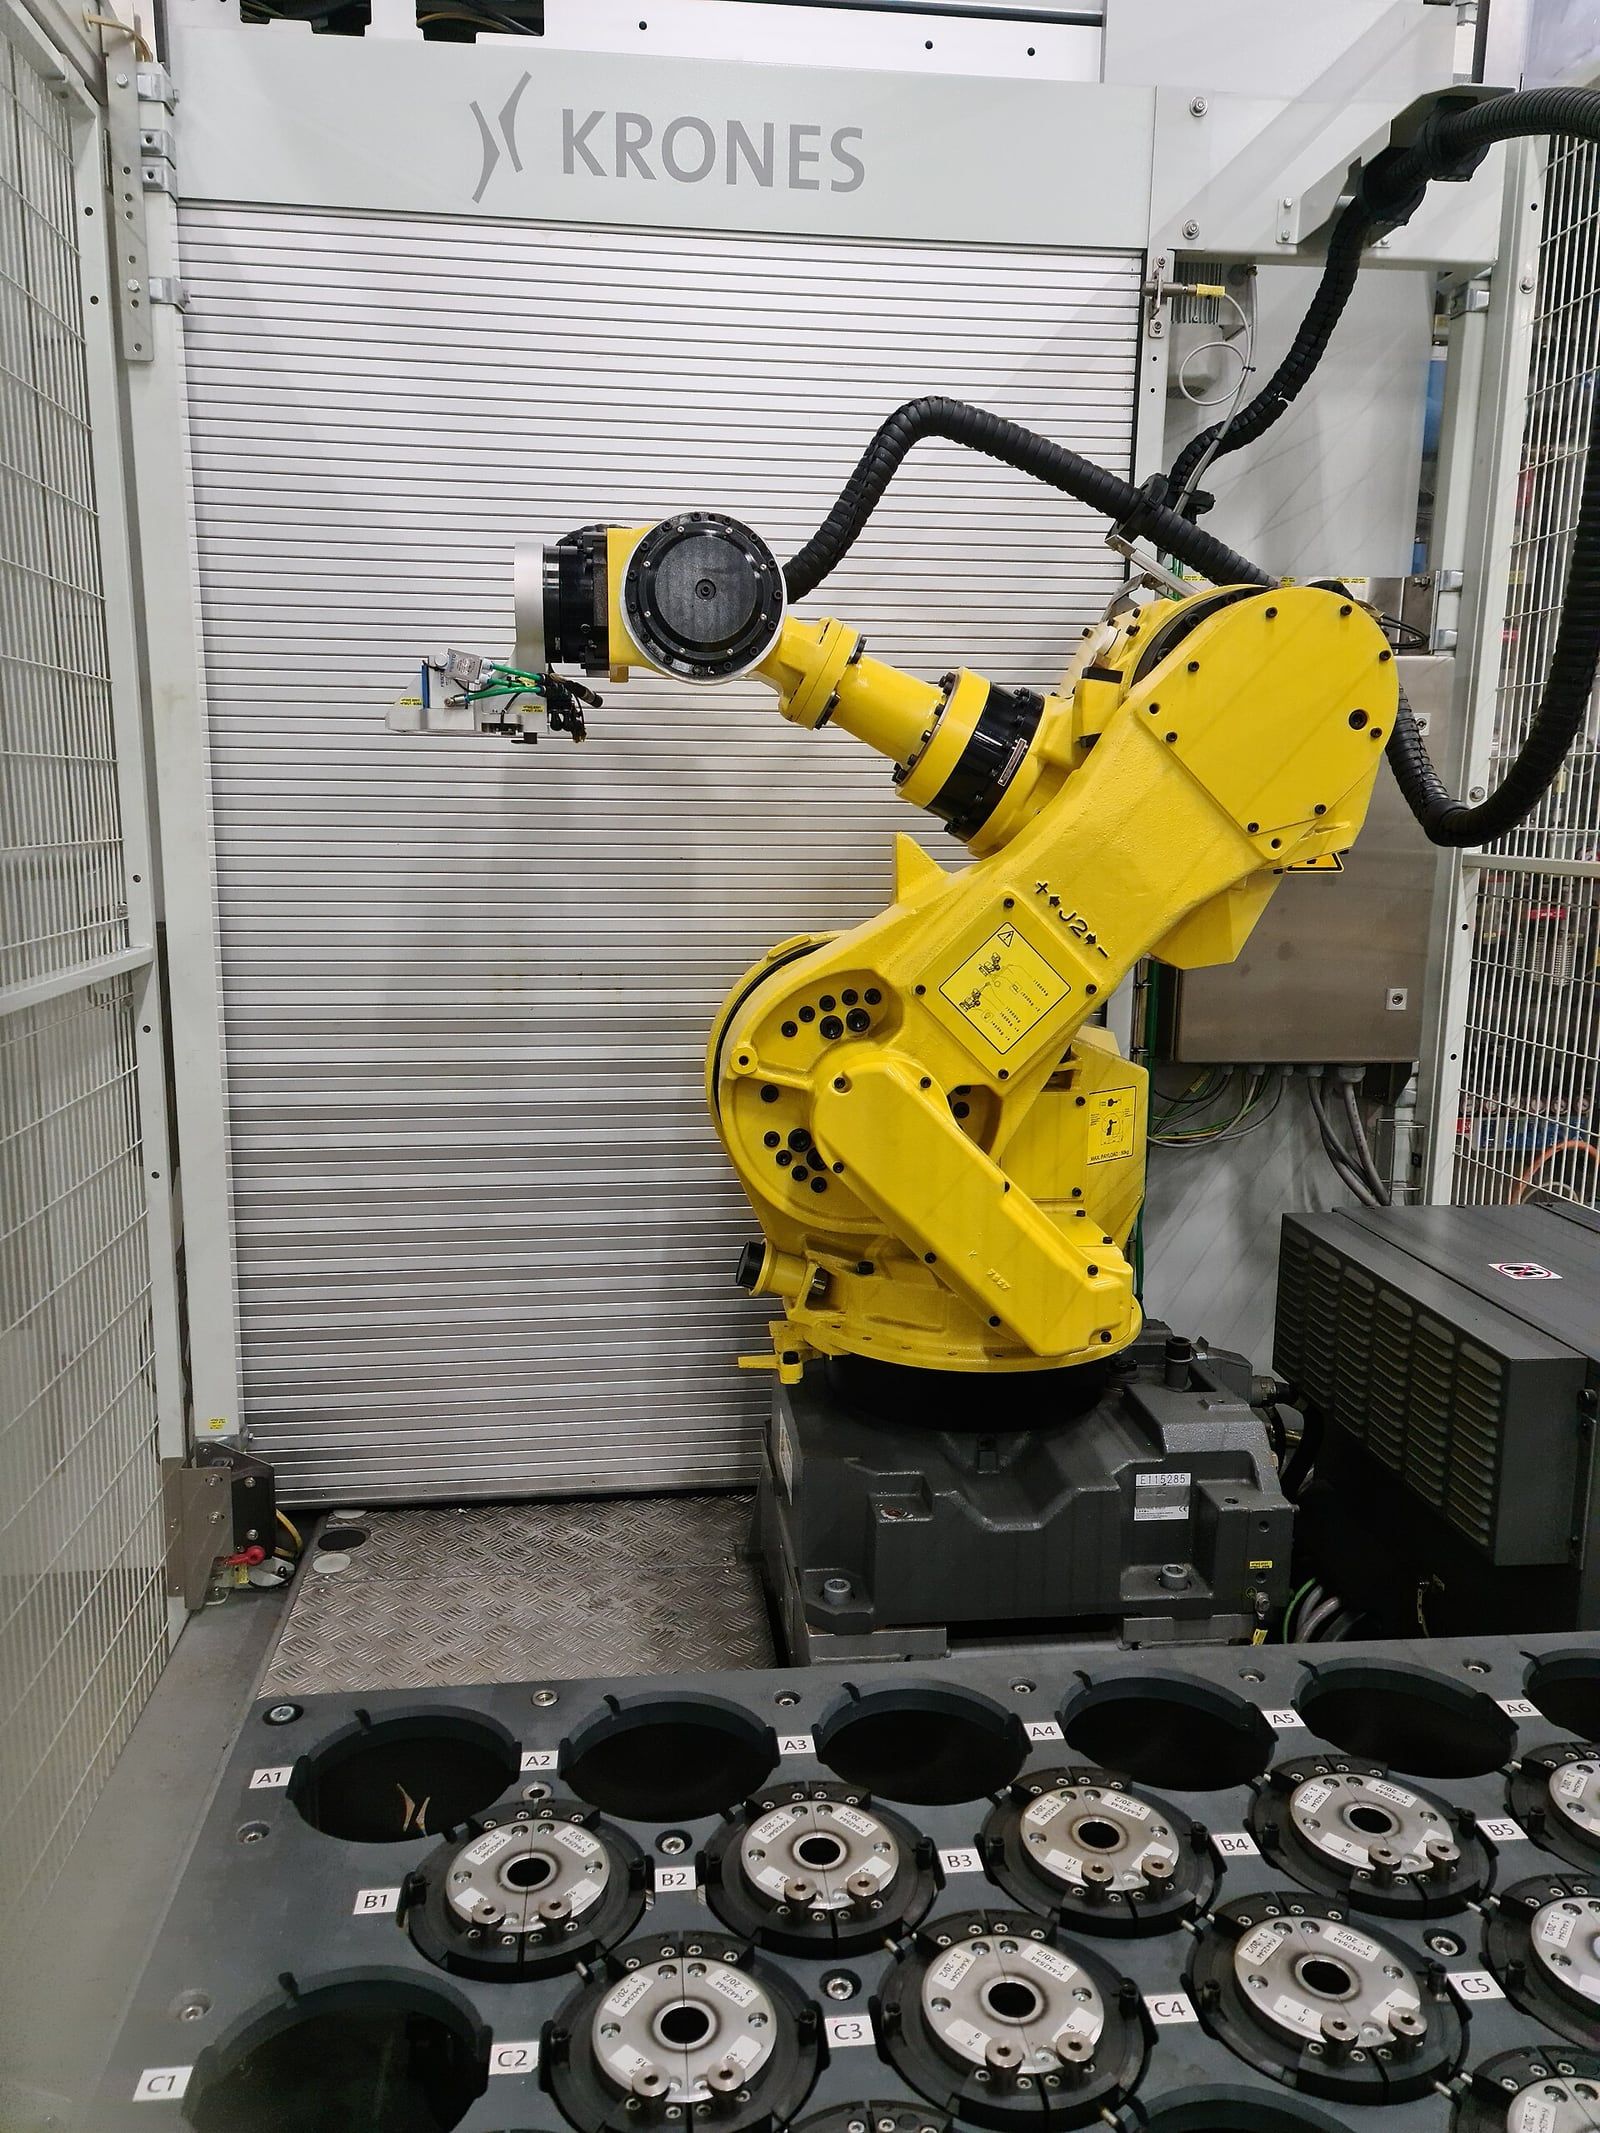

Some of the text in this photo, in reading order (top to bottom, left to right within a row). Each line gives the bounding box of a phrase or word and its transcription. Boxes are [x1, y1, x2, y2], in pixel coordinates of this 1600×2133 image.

[562, 108, 865, 193] KRONES
[1058, 909, 1088, 938] J2
[1140, 1474, 1186, 1485] E115285
[1507, 1703, 1532, 1713] A6
[1272, 1713, 1295, 1724] A5
[1032, 1725, 1056, 1737] A4
[784, 1739, 808, 1751] A3
[525, 1754, 550, 1767] A2
[256, 1770, 282, 1786] A1
[1491, 1822, 1516, 1836] B5
[1222, 1838, 1250, 1852] B4
[948, 1854, 972, 1868] B3
[662, 1872, 686, 1886] B2
[364, 1894, 388, 1908] B1
[1036, 1949, 1056, 1963] 20/2
[938, 1963, 954, 1978] 20/2
[722, 1973, 740, 1988] 20/2
[1460, 1978, 1490, 1994] C5
[612, 1987, 628, 2004] 20/2
[1154, 2002, 1186, 2017] C4
[834, 2022, 862, 2040] C3
[974, 2032, 982, 2040] 9
[498, 2050, 528, 2066] C2
[146, 2074, 176, 2094] C1
